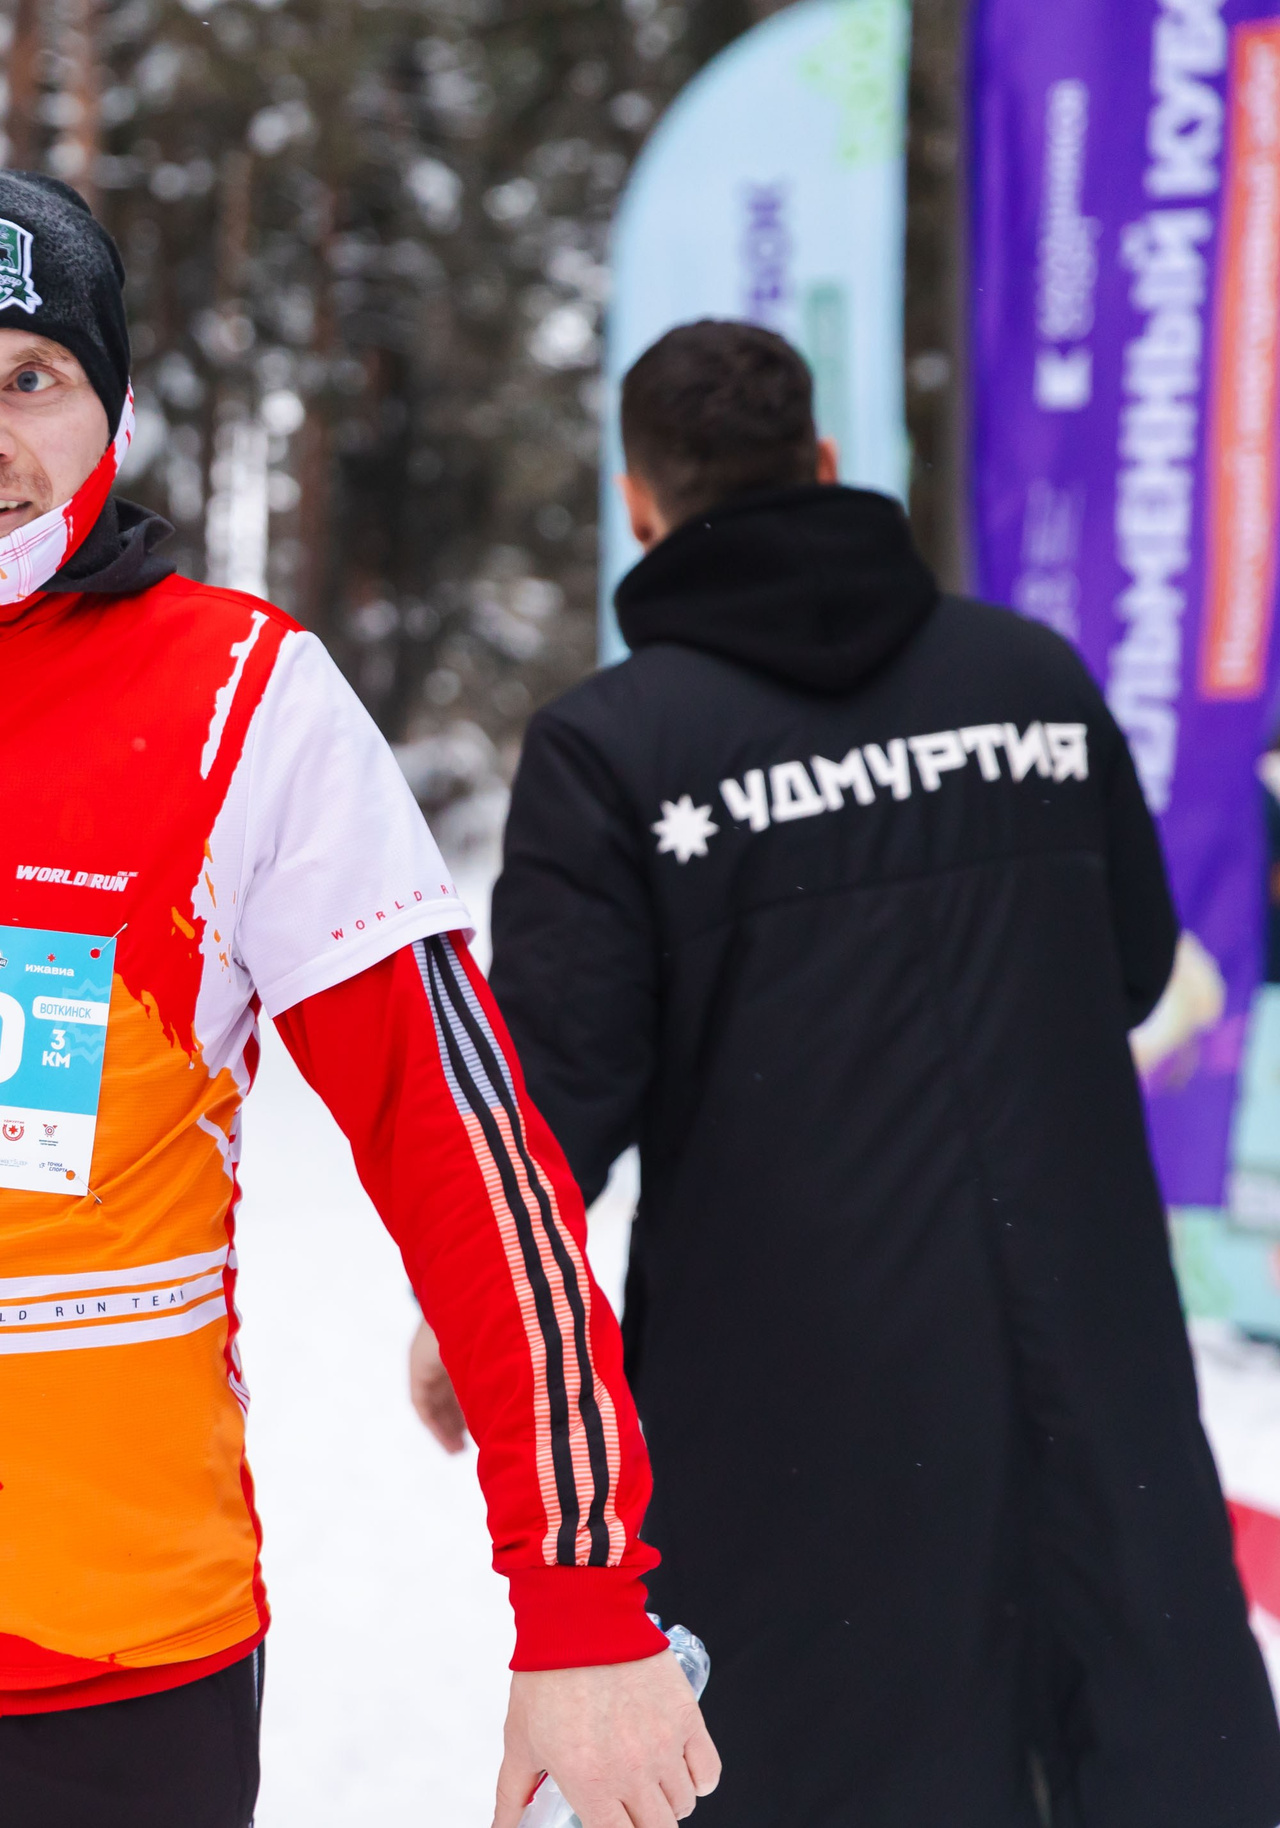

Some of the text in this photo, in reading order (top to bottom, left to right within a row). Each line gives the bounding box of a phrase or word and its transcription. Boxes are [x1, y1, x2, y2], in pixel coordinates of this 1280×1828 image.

[1110, 0, 1228, 813] ЛЬМЕННЫЙ КУБ
[721, 720, 1088, 832] УДМУРТИЯ
[16, 865, 129, 892] WORLD RUN
[331, 884, 457, 940] WORLD R
[40, 1002, 91, 1019] ВОТКИНСК
[50, 1028, 66, 1050] 3
[41, 1051, 70, 1068] КМ
[56, 1301, 106, 1317] RUN
[132, 1290, 184, 1308] TEA
